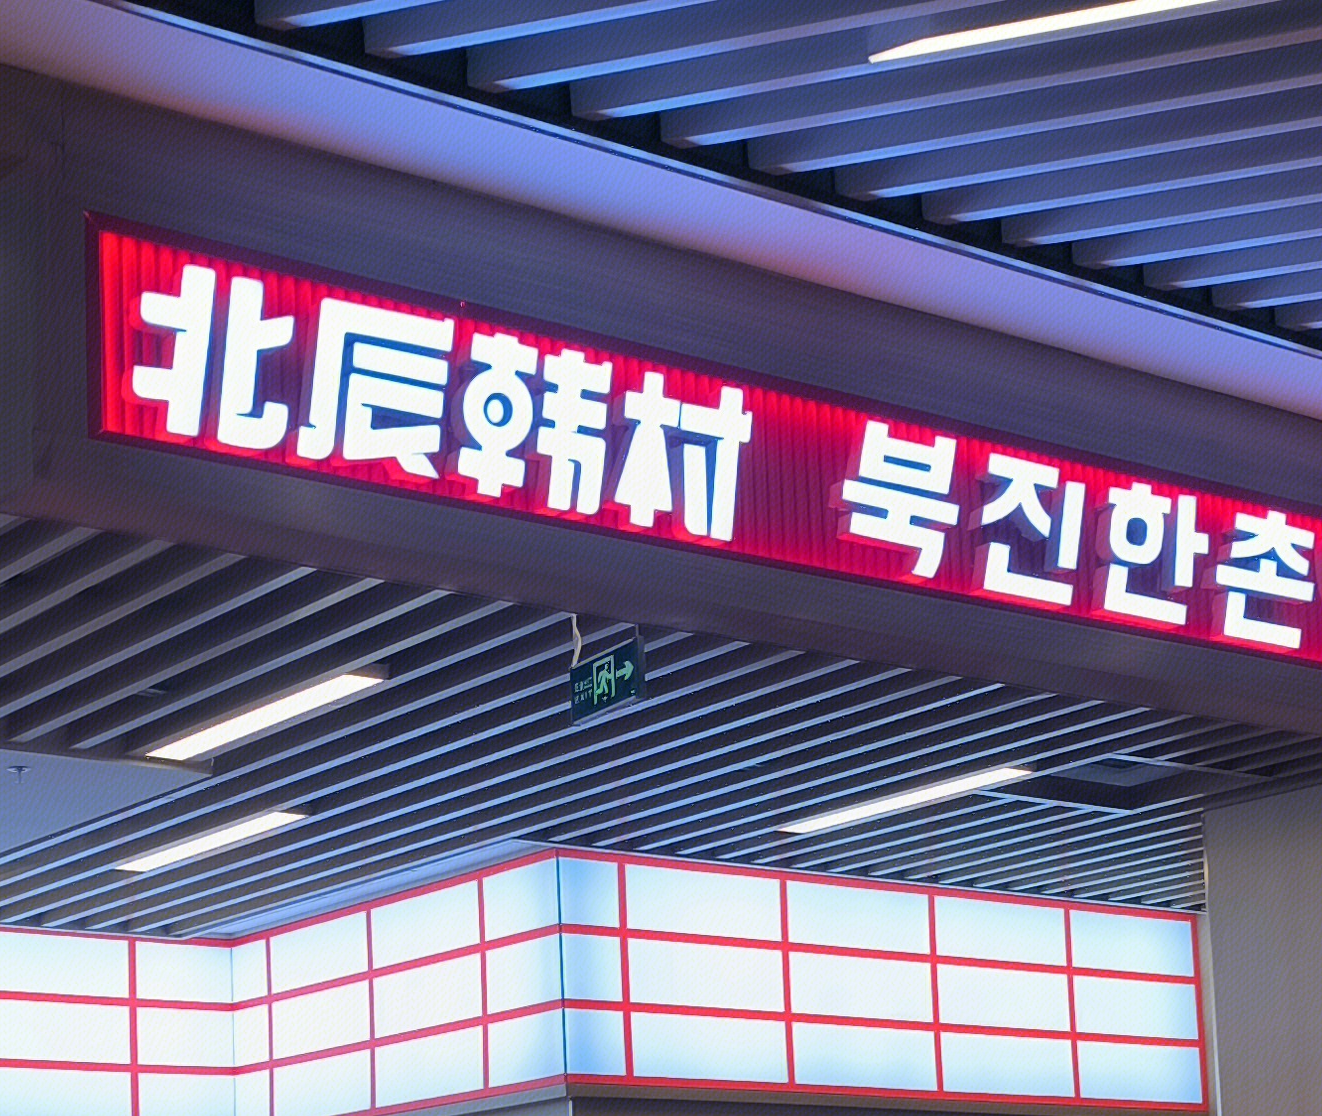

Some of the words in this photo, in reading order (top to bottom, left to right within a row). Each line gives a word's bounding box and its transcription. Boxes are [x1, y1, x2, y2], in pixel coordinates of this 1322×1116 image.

[131, 264, 752, 542] 北辰韩村
[841, 420, 1317, 651] 북진한촌
